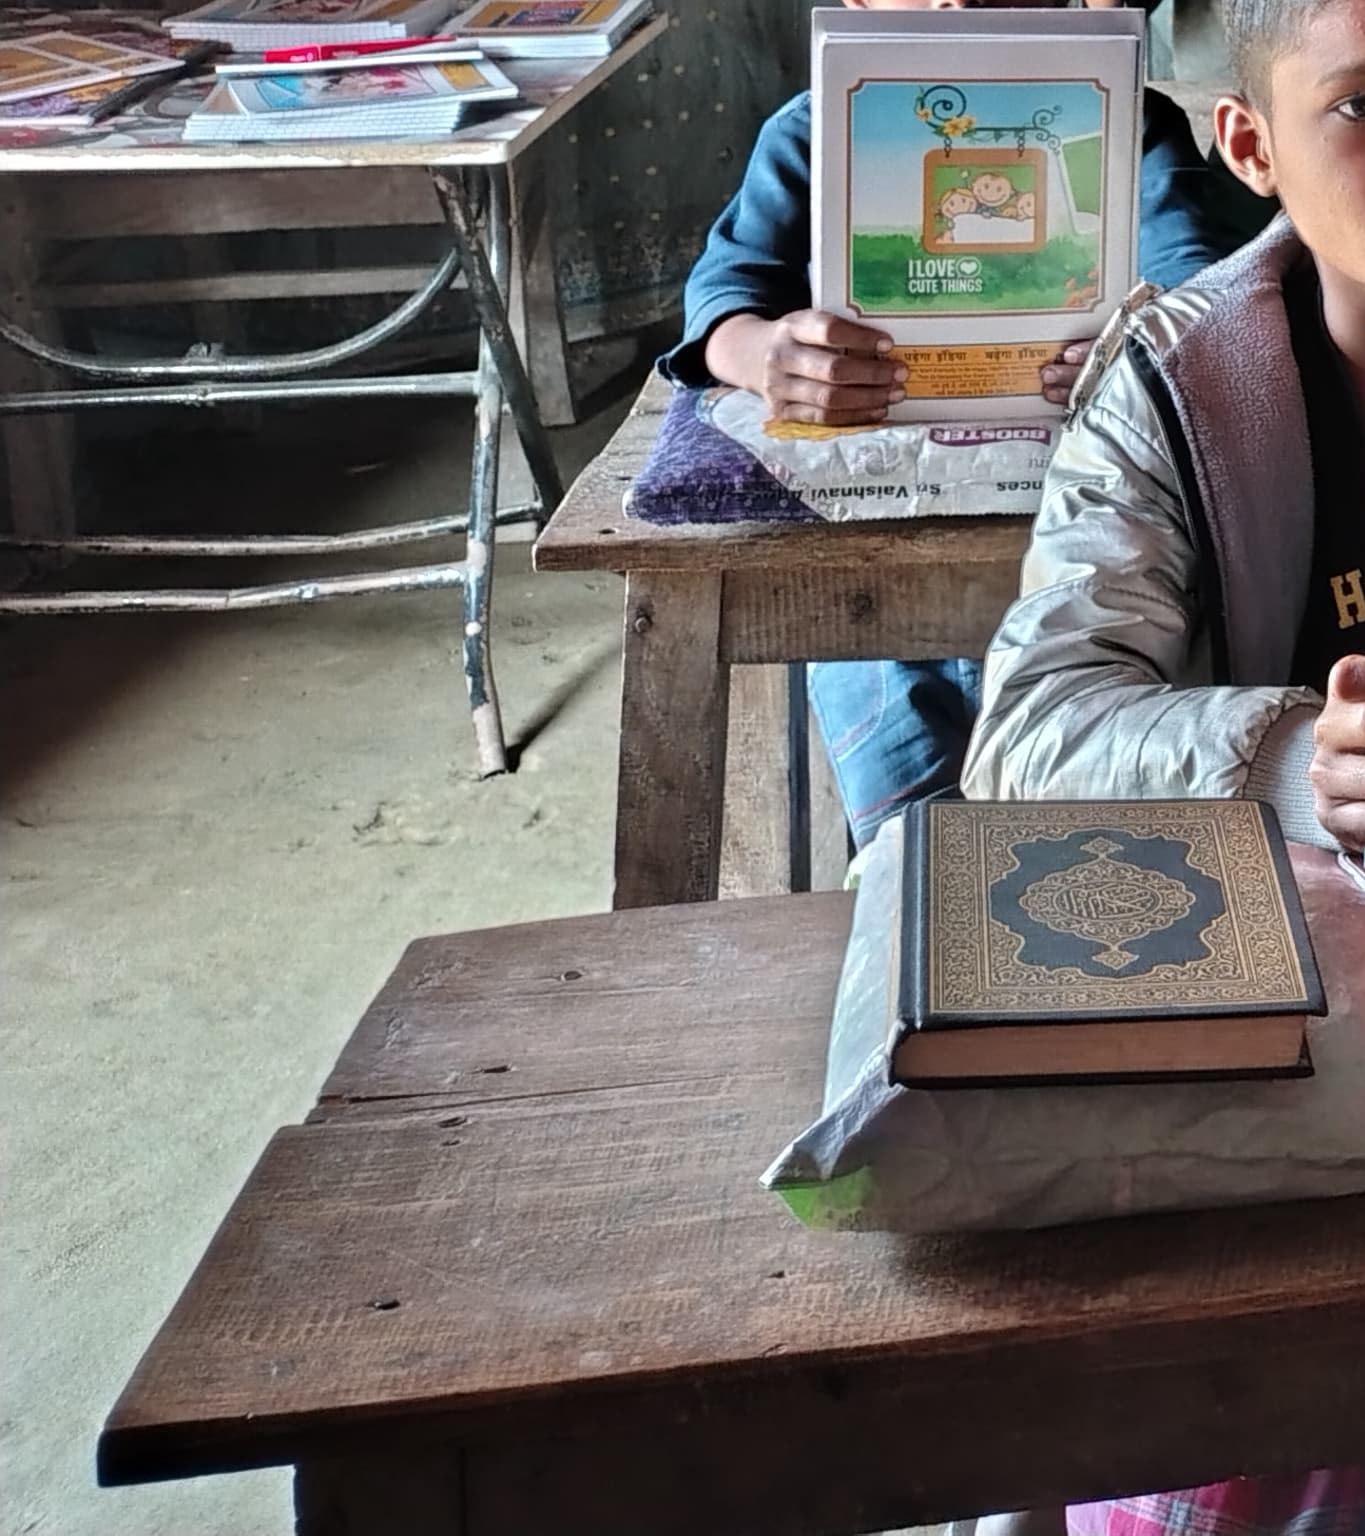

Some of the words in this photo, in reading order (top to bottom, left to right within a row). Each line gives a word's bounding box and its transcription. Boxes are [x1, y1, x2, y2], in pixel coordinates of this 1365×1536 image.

[915, 258, 957, 278] LOVE
[908, 279, 939, 294] CUTE
[942, 278, 983, 293] THINGS
[934, 427, 1046, 442] BOOSTER
[810, 482, 908, 502] Vaishnavi
[917, 482, 941, 496] Sri
